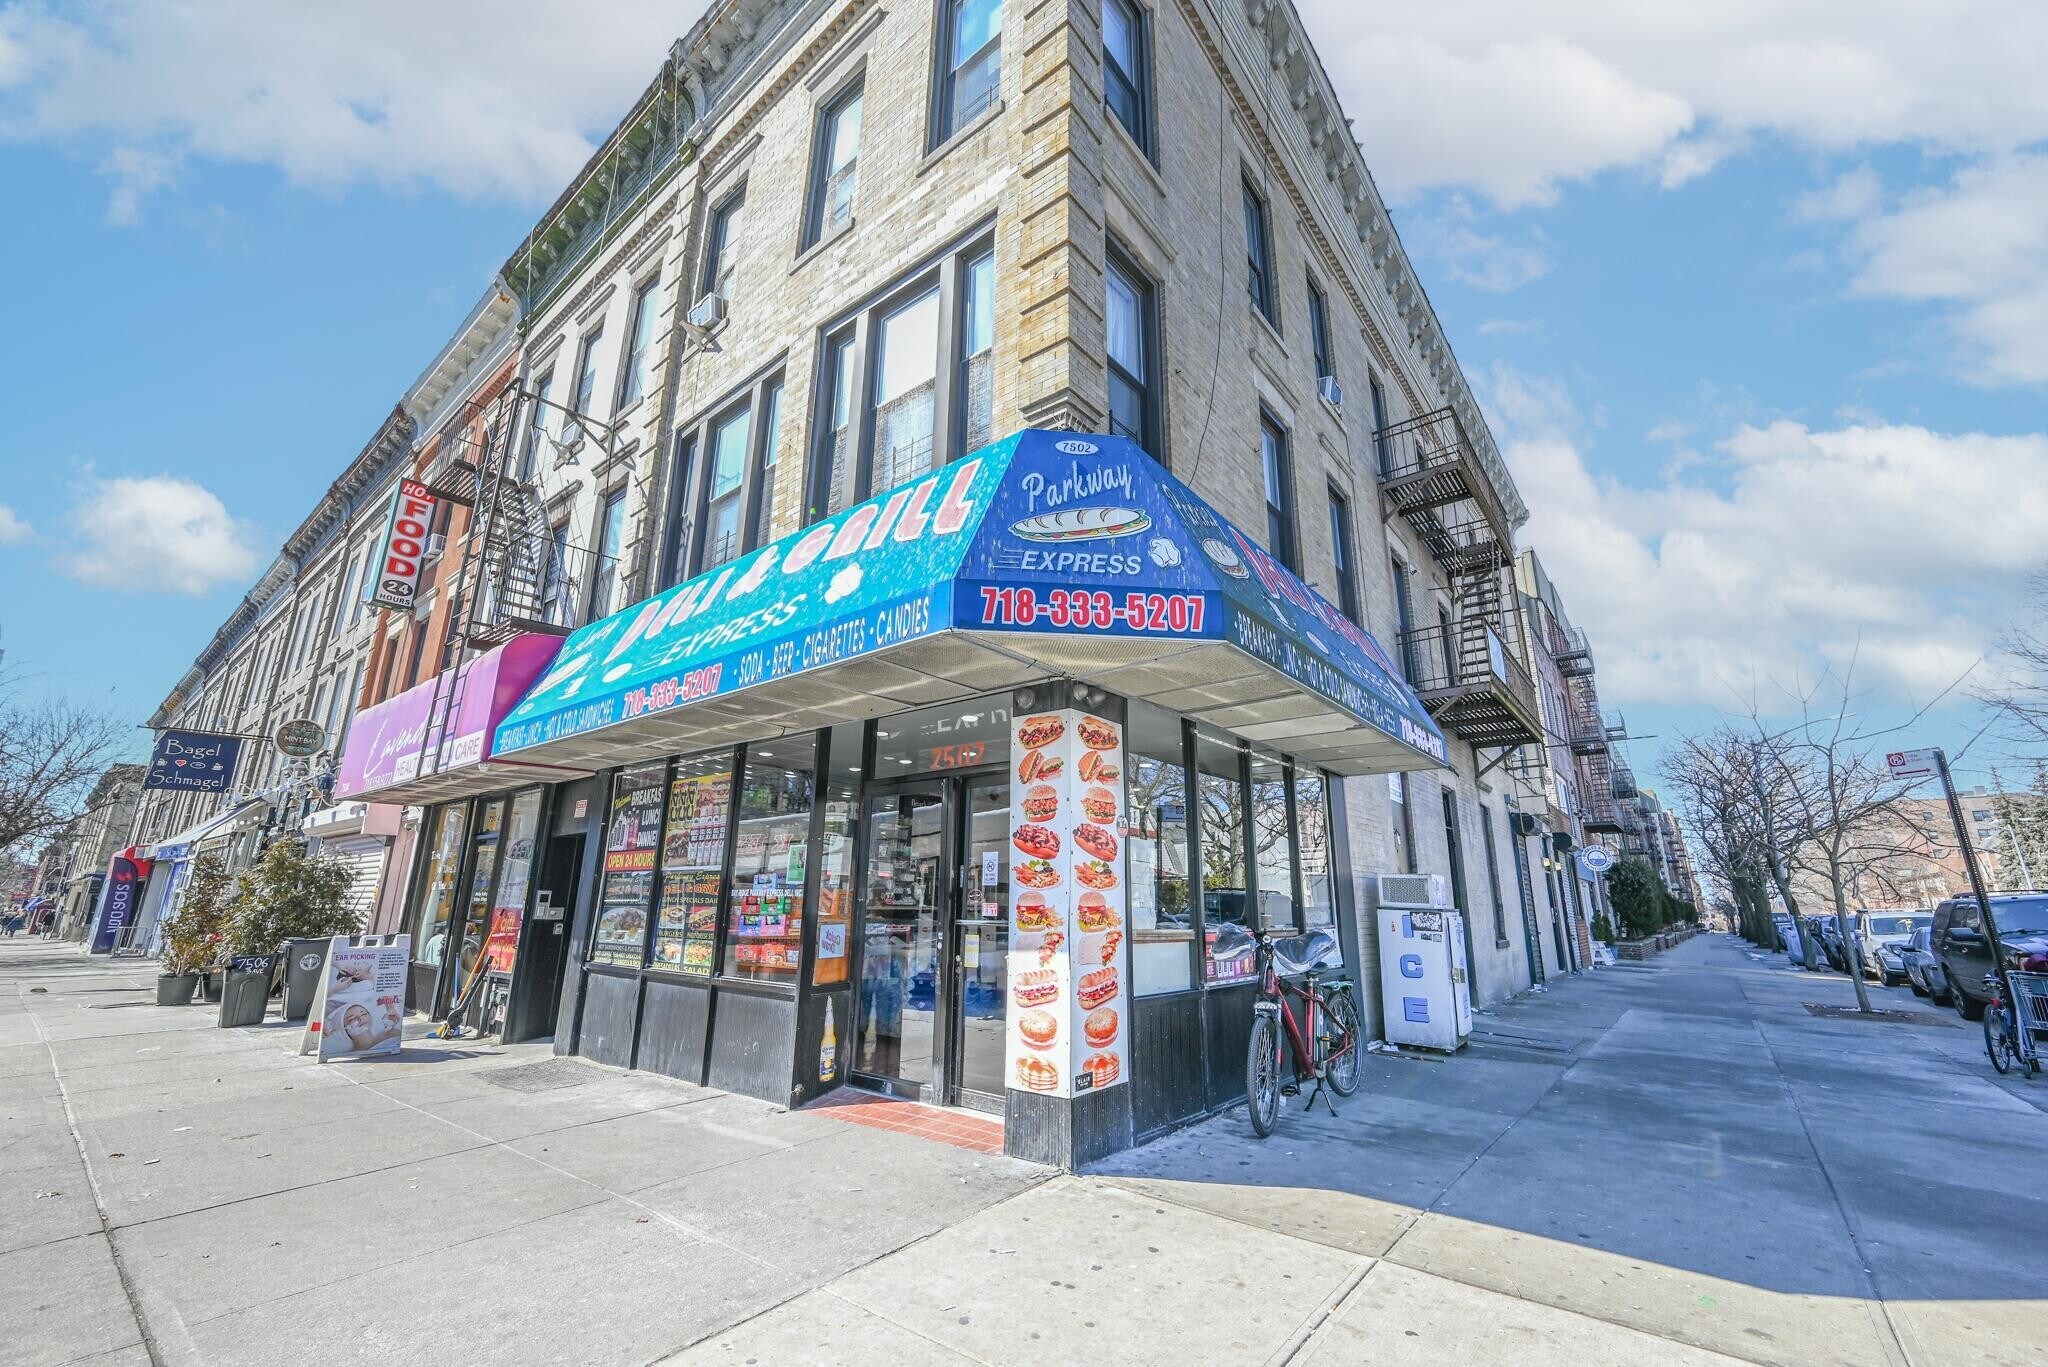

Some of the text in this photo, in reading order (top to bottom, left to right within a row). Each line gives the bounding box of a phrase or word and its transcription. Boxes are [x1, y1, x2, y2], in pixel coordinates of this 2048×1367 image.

[1062, 442, 1092, 453] 7502
[403, 482, 432, 500] HO
[1021, 460, 1133, 512] Parkway
[387, 499, 429, 577] FOOD
[600, 566, 736, 666] DELI
[783, 457, 983, 575] GRILL
[1020, 551, 1142, 575] EXPRESS
[380, 592, 411, 606] HOURS
[387, 580, 410, 596] 24
[981, 586, 1206, 633] 718-333-5207
[659, 593, 807, 667] EXPRESS
[621, 662, 723, 719] 718-333-5207
[738, 650, 763, 686] SODA
[771, 640, 795, 677] BEER
[802, 616, 866, 669] CIGARETTES
[875, 596, 930, 646] CANDIES
[165, 739, 221, 759] Bagel
[455, 736, 481, 760] CARE
[930, 741, 985, 769] 7502
[150, 769, 224, 790] Schmagel
[608, 852, 656, 868] OPEN 24 HOURS
[238, 957, 269, 970] 7506
[350, 953, 376, 961] PICKING
[684, 967, 710, 975] SALAD
[1400, 914, 1430, 1024] ICE
